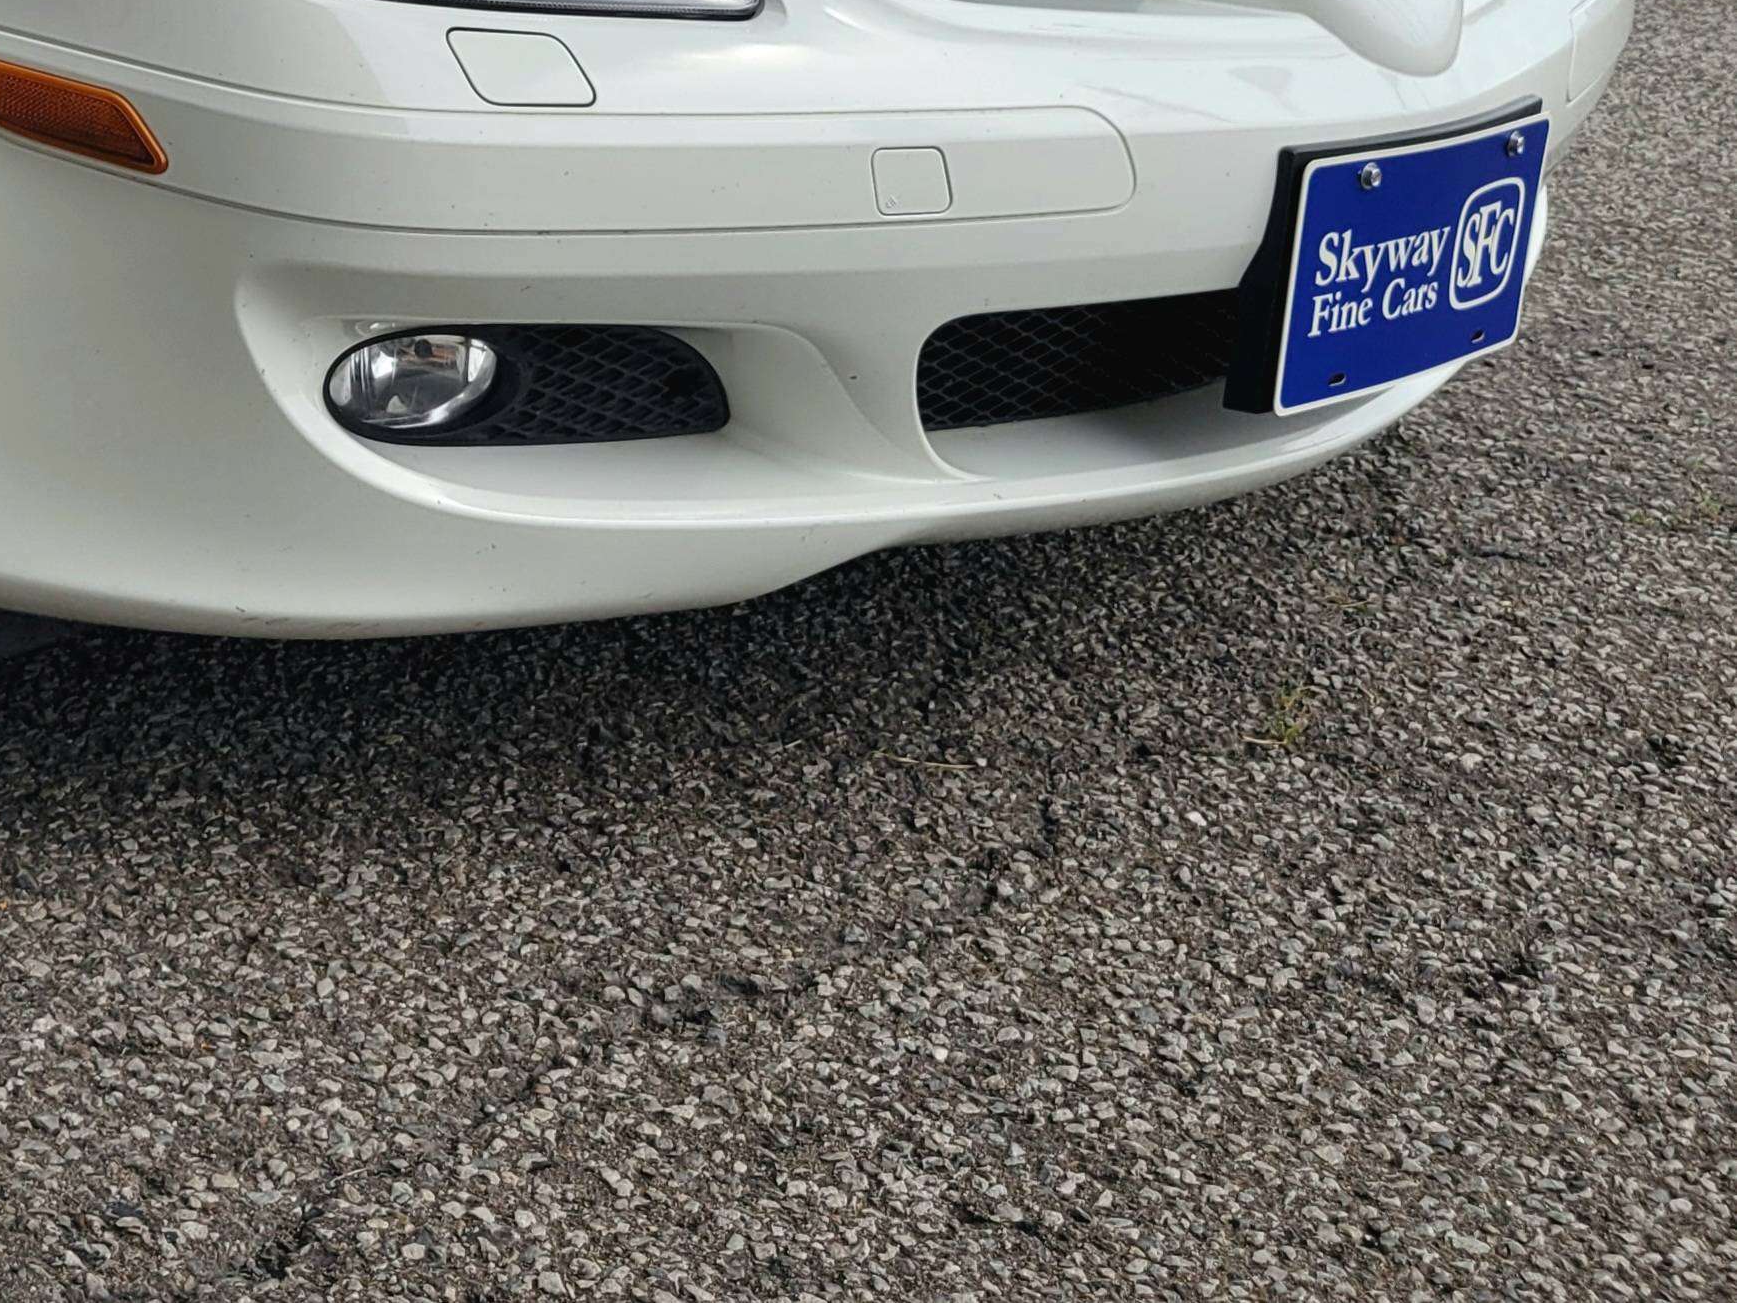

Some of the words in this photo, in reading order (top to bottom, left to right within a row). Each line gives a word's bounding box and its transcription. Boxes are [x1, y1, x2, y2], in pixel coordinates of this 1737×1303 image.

[1315, 226, 1451, 293] Skyway
[1458, 201, 1515, 289] SFC
[1307, 291, 1372, 338] Fine
[1382, 277, 1438, 320] Cars
